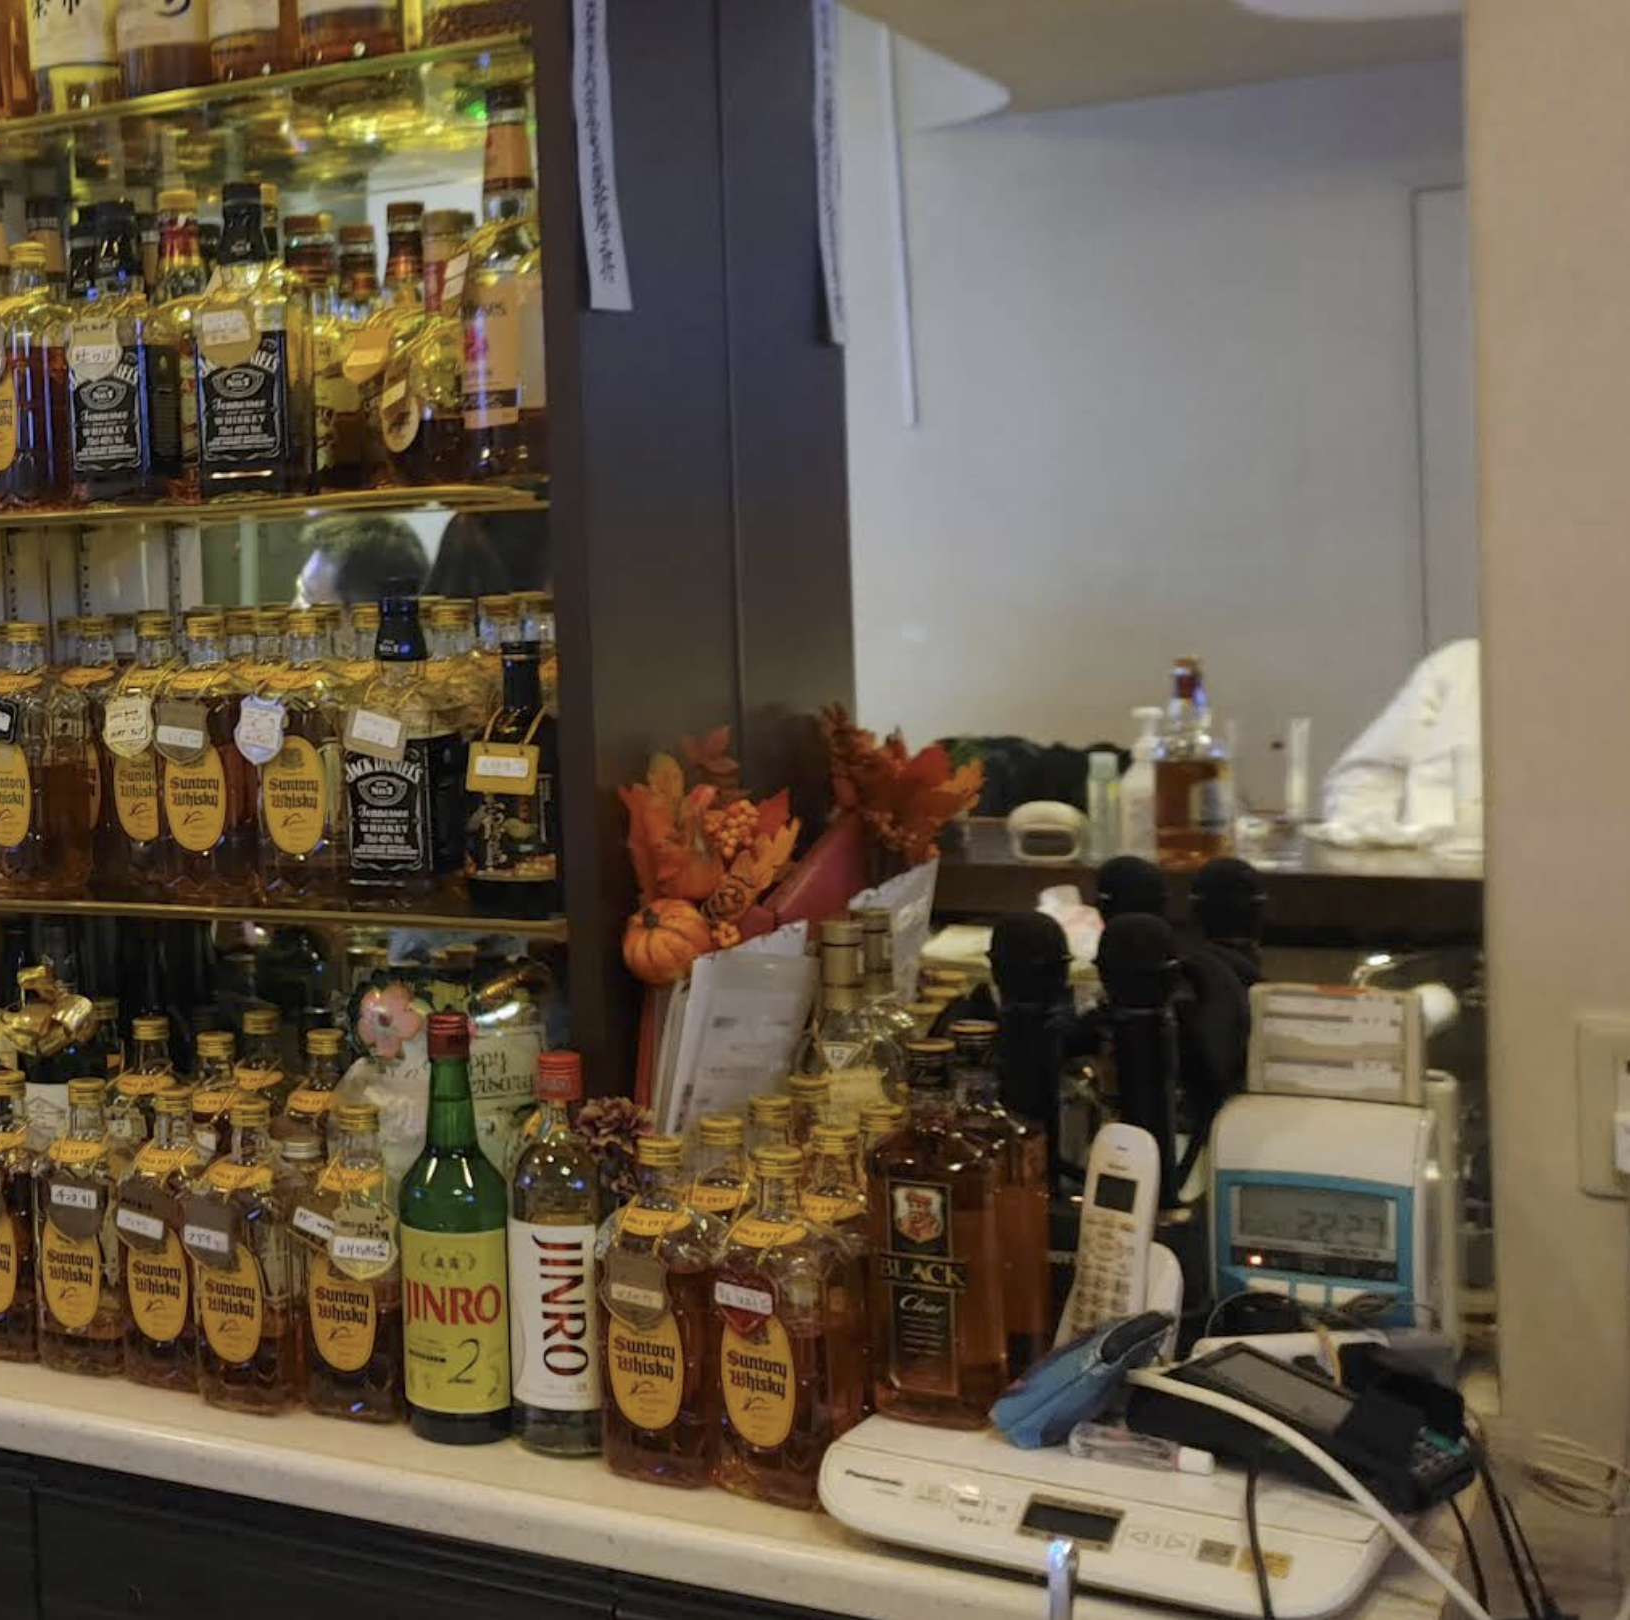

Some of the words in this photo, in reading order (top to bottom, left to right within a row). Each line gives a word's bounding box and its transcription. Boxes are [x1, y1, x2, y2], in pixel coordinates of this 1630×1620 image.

[214, 414, 266, 425] WHISKEY
[346, 758, 371, 784] JACK
[170, 776, 219, 792] Suntory
[270, 777, 319, 793] Suntory
[171, 792, 219, 809] Whisky
[271, 793, 318, 810] Whisky
[360, 823, 408, 834] WHISKEY
[47, 1249, 93, 1269] Suntory
[132, 1260, 181, 1281] Suntory
[48, 1265, 92, 1287] Whisky
[880, 1257, 967, 1288] BLACK
[133, 1277, 180, 1299] Whisky
[205, 1278, 255, 1300] Suntory
[315, 1285, 369, 1308] Suntory
[206, 1296, 254, 1320] Whisky
[406, 1276, 502, 1326] JINRO
[531, 1234, 589, 1377] JINRO
[316, 1302, 368, 1325] Whisky
[447, 1338, 481, 1385] 2
[614, 1336, 675, 1364] Suntory
[615, 1355, 674, 1383] Whisky
[727, 1350, 787, 1381] Suntory
[728, 1369, 786, 1401] Whisky
